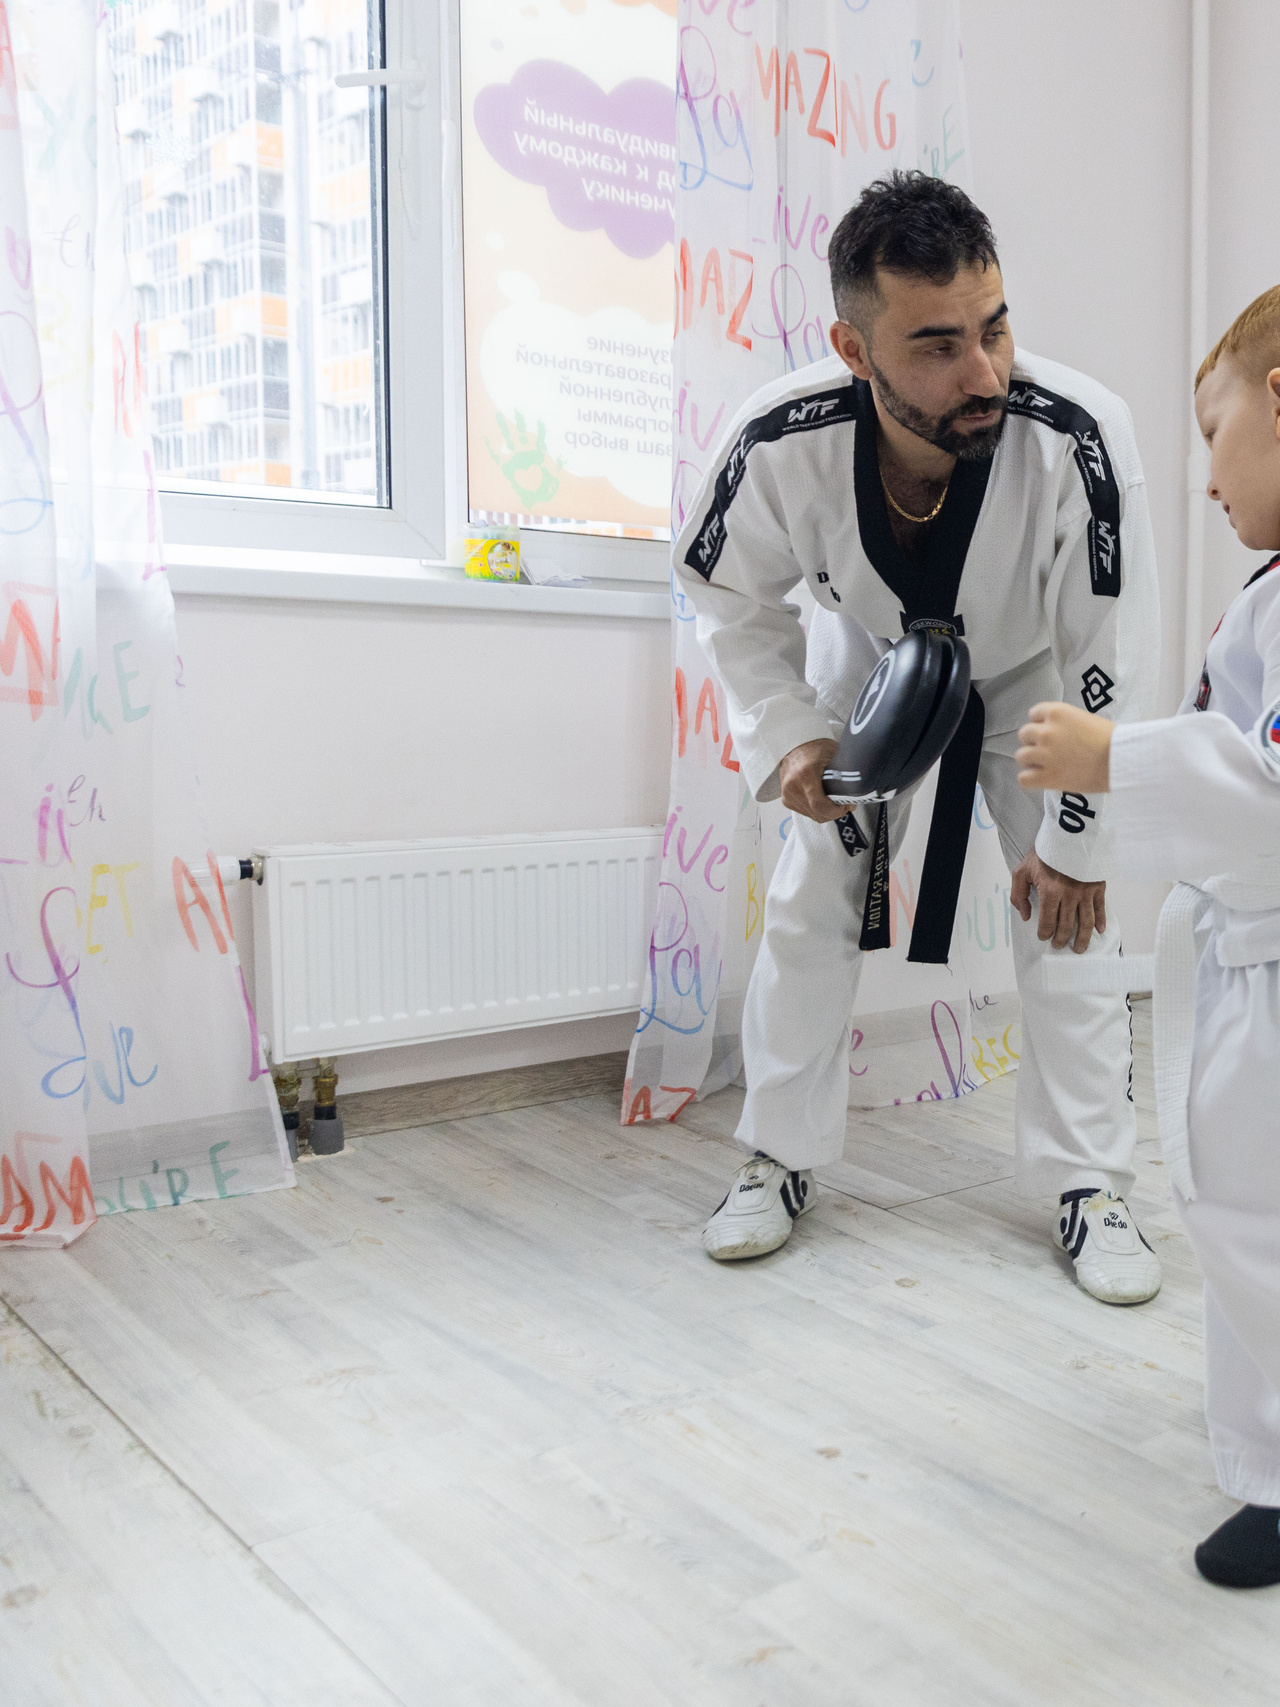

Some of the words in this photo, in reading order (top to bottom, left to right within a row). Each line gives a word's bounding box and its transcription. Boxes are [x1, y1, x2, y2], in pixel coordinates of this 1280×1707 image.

[787, 398, 839, 423] WTF
[698, 513, 720, 564] WTF
[1098, 520, 1116, 575] WTF
